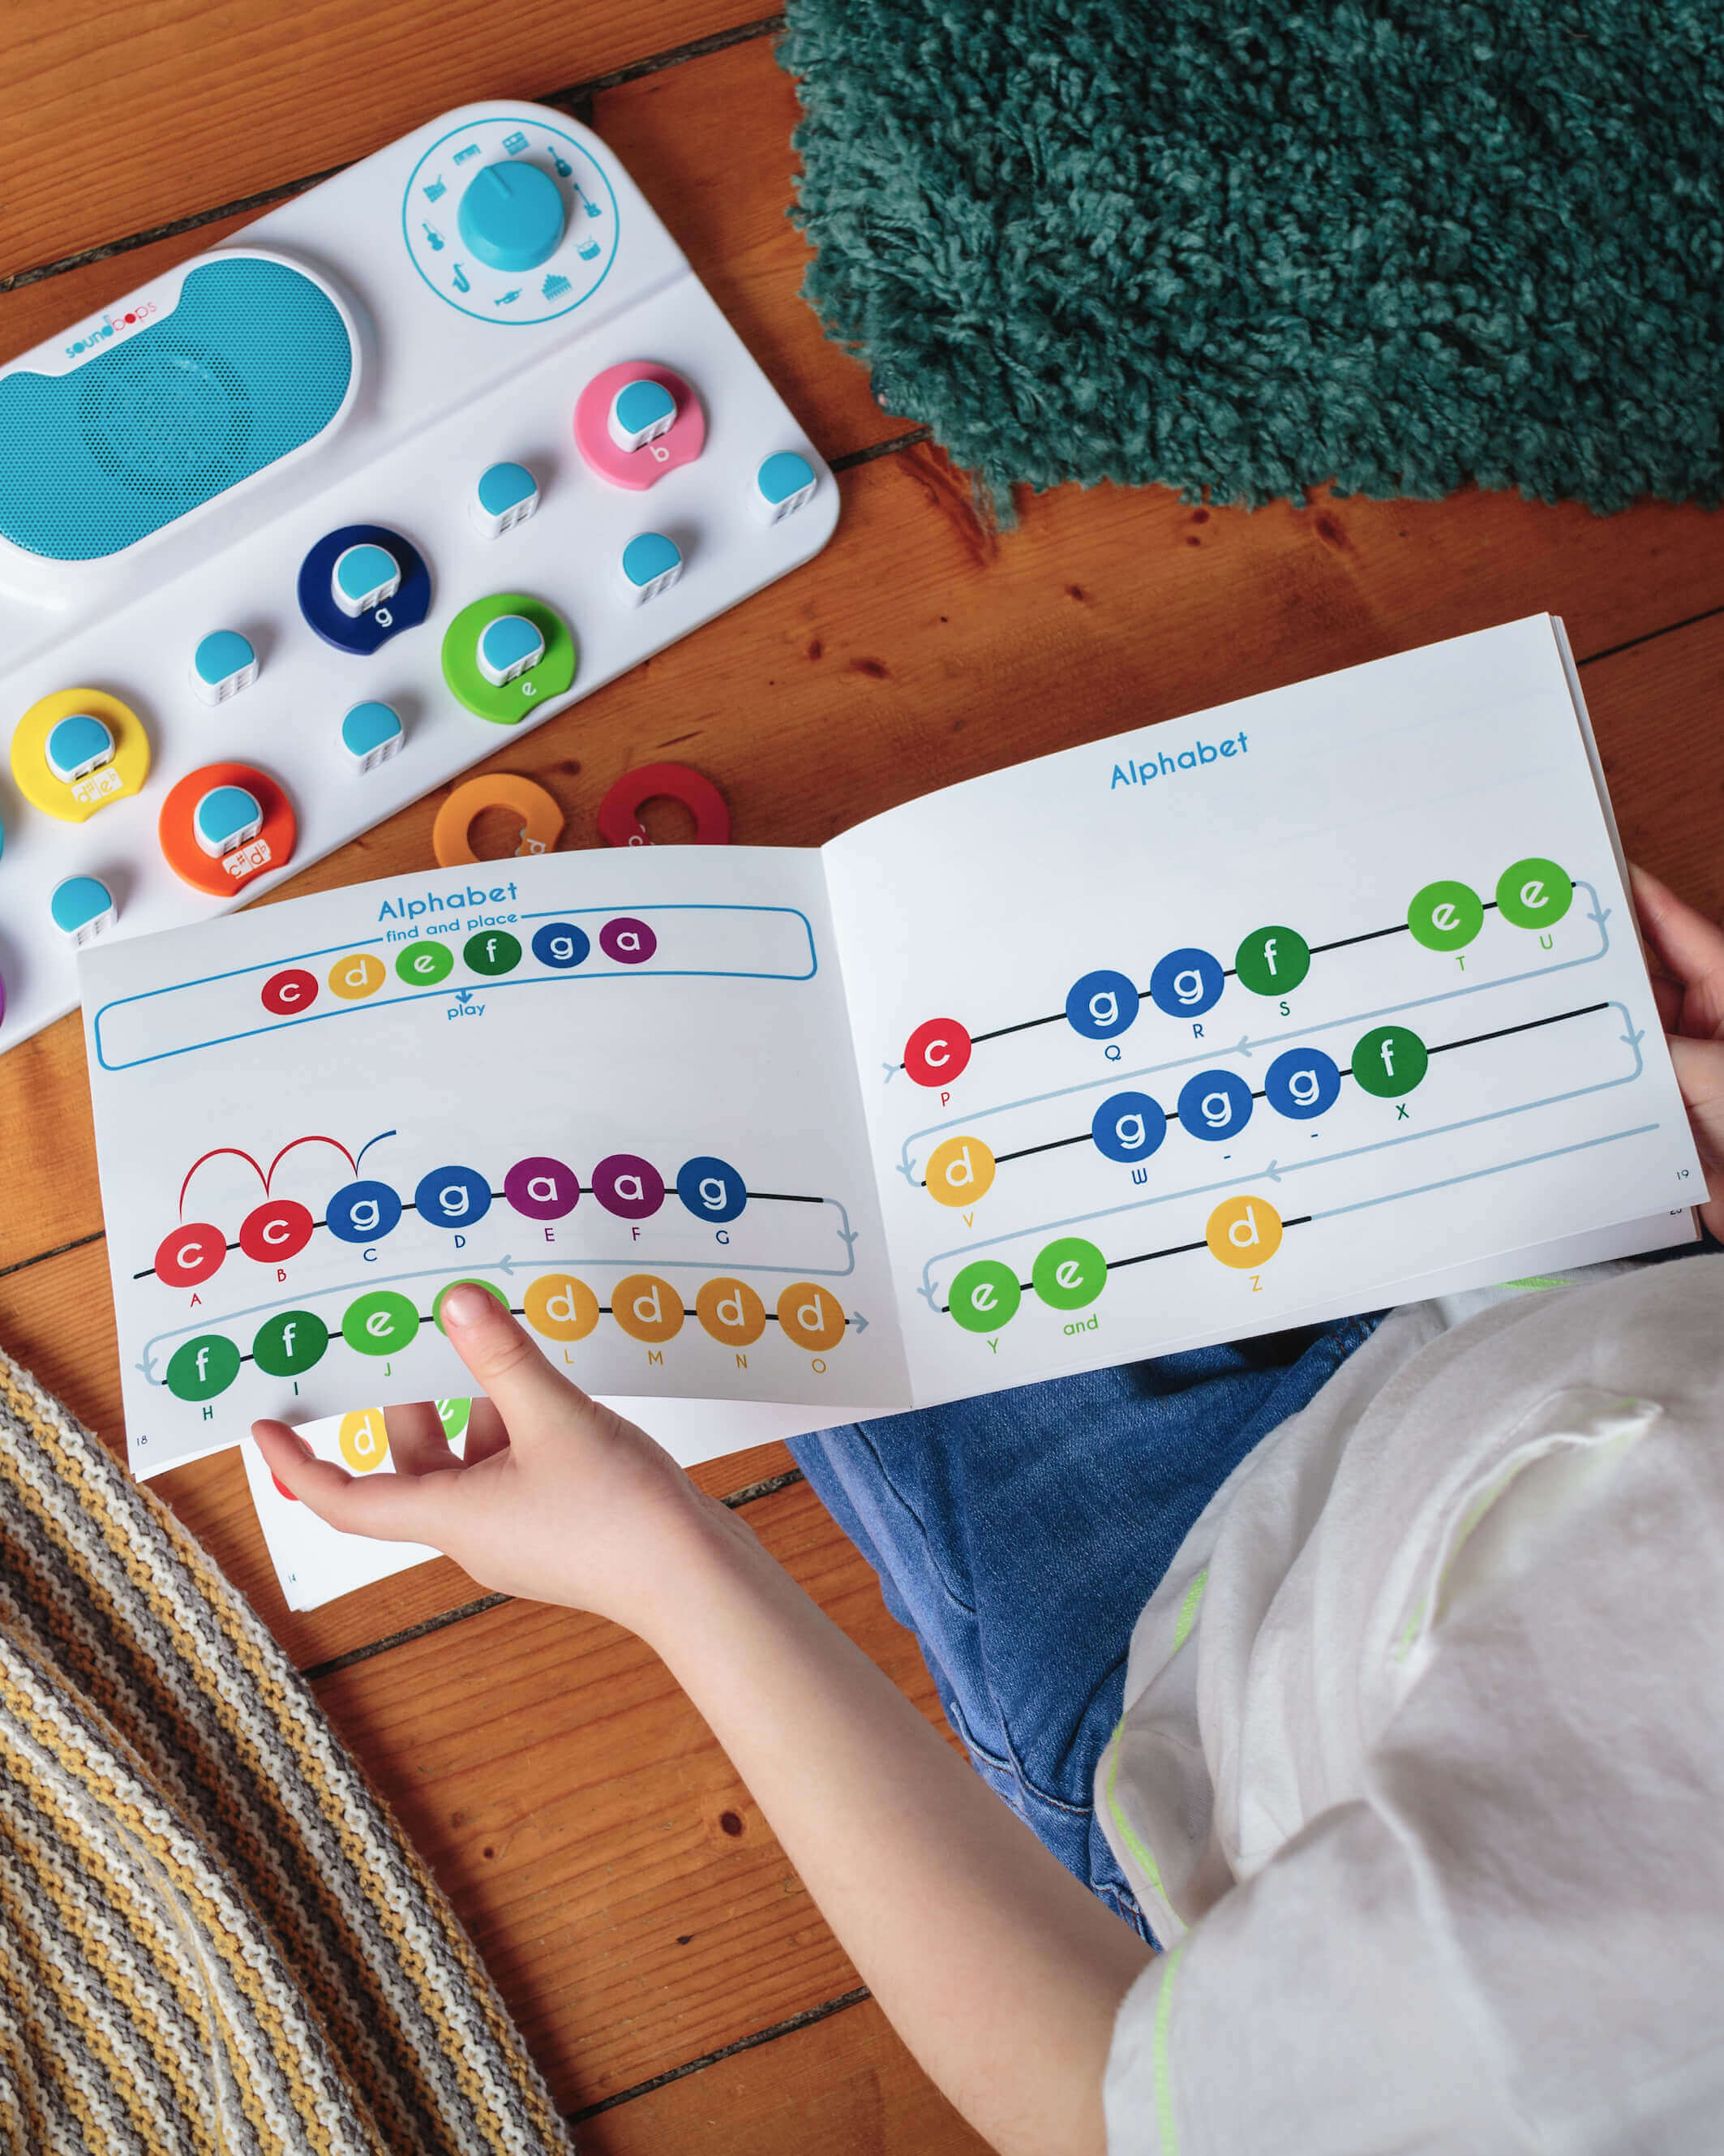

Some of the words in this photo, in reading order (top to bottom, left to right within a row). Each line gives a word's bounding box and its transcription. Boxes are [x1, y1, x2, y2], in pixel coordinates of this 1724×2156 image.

[65, 301, 157, 359] soundbops
[375, 608, 393, 628] g
[521, 681, 537, 696] e
[1111, 732, 1247, 789] Alphabet
[378, 882, 517, 921] Alphabet
[386, 926, 418, 943] find
[427, 919, 460, 936] and
[467, 912, 518, 931] place
[279, 983, 301, 1003] c
[345, 960, 368, 987] d
[414, 955, 435, 973] e
[486, 938, 497, 963] f
[550, 937, 574, 960] g
[616, 932, 641, 951] a
[924, 1039, 950, 1067] c
[1088, 991, 1119, 1027] g
[1173, 969, 1204, 1005] g
[1263, 938, 1277, 976] f
[1431, 903, 1460, 931] e
[1520, 880, 1550, 908] e
[447, 1003, 486, 1020] play
[940, 1091, 950, 1107] P
[1104, 1045, 1121, 1062] Q
[1192, 1023, 1204, 1039] R
[1280, 1001, 1291, 1017] S
[1455, 955, 1465, 971] T
[1539, 934, 1554, 950] U
[945, 1146, 974, 1187] d
[1115, 1113, 1146, 1149] g
[1201, 1091, 1233, 1127] g
[1289, 1069, 1320, 1106] g
[1380, 1038, 1395, 1077] f
[963, 1212, 974, 1228] V
[1396, 1102, 1410, 1121] X
[1676, 1169, 1689, 1180] 19
[177, 1243, 204, 1269] c
[262, 1219, 290, 1244] c
[350, 1200, 380, 1231] g
[439, 1185, 470, 1217] g
[527, 1176, 559, 1202] a
[614, 1175, 645, 1200] a
[699, 1178, 727, 1210] g
[190, 1292, 202, 1308] A
[277, 1268, 287, 1282] B
[362, 1248, 378, 1262] C
[454, 1235, 466, 1248] D
[544, 1227, 555, 1242] E
[632, 1226, 641, 1242] F
[715, 1230, 730, 1245] G
[971, 1283, 998, 1312] e
[1055, 1261, 1084, 1289] e
[1228, 1205, 1260, 1248] d
[195, 1346, 210, 1382] f
[282, 1322, 297, 1357] f
[366, 1311, 395, 1338] e
[546, 1284, 577, 1322] d
[633, 1285, 663, 1323] d
[716, 1290, 745, 1326] d
[796, 1295, 825, 1331] d
[987, 1338, 999, 1355] Y
[1063, 1314, 1099, 1336] and
[1249, 1274, 1263, 1292] Z
[202, 1405, 213, 1421] H
[384, 1362, 392, 1376] J
[564, 1349, 575, 1364] L
[647, 1350, 664, 1365] M
[735, 1354, 748, 1369] N
[136, 1435, 148, 1446] 18
[354, 1415, 376, 1455] d
